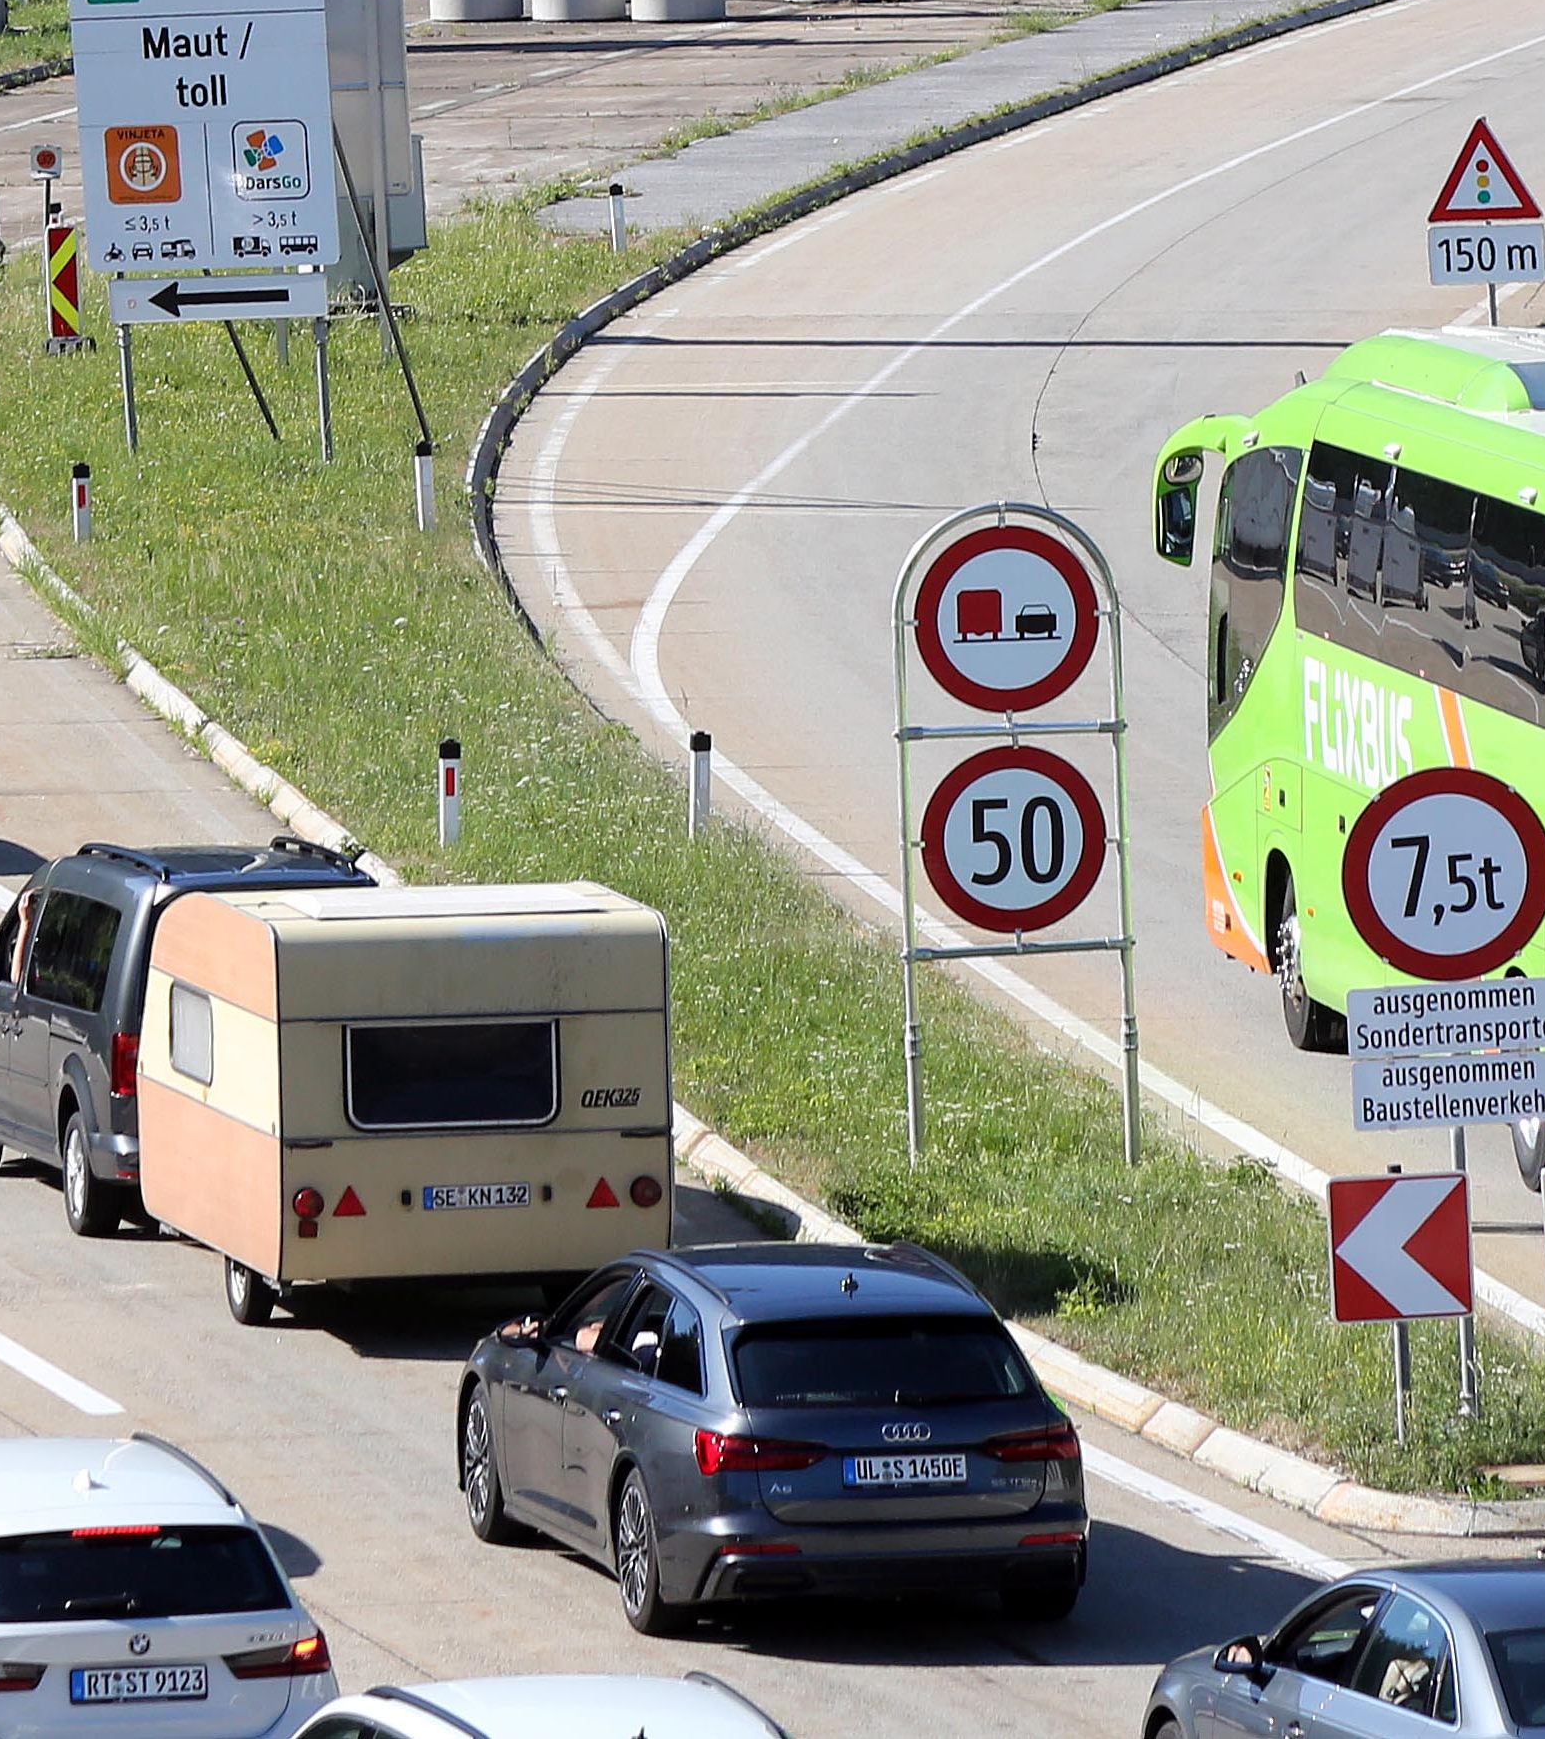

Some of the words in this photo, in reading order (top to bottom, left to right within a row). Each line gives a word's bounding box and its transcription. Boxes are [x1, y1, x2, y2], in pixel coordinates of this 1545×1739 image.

[142, 25, 229, 60] Maut
[239, 21, 254, 60] /
[175, 74, 228, 107] toll
[116, 129, 166, 141] VINJETA
[246, 176, 302, 191] DarsGo
[1437, 236, 1496, 273] 150
[1506, 244, 1537, 271] m
[971, 796, 1065, 886] 50
[1372, 985, 1536, 1019] ausgenommen
[1382, 1059, 1536, 1092] ausgenommen
[435, 1188, 457, 1207] SE
[468, 1187, 492, 1205] KN
[496, 1186, 528, 1204] 132
[857, 1459, 880, 1480] UL
[894, 1460, 905, 1479] S
[909, 1457, 964, 1479] 1450E
[769, 1482, 792, 1495] A6
[87, 1672, 112, 1695] RT
[126, 1670, 150, 1694] ST
[155, 1669, 204, 1693] 9123
